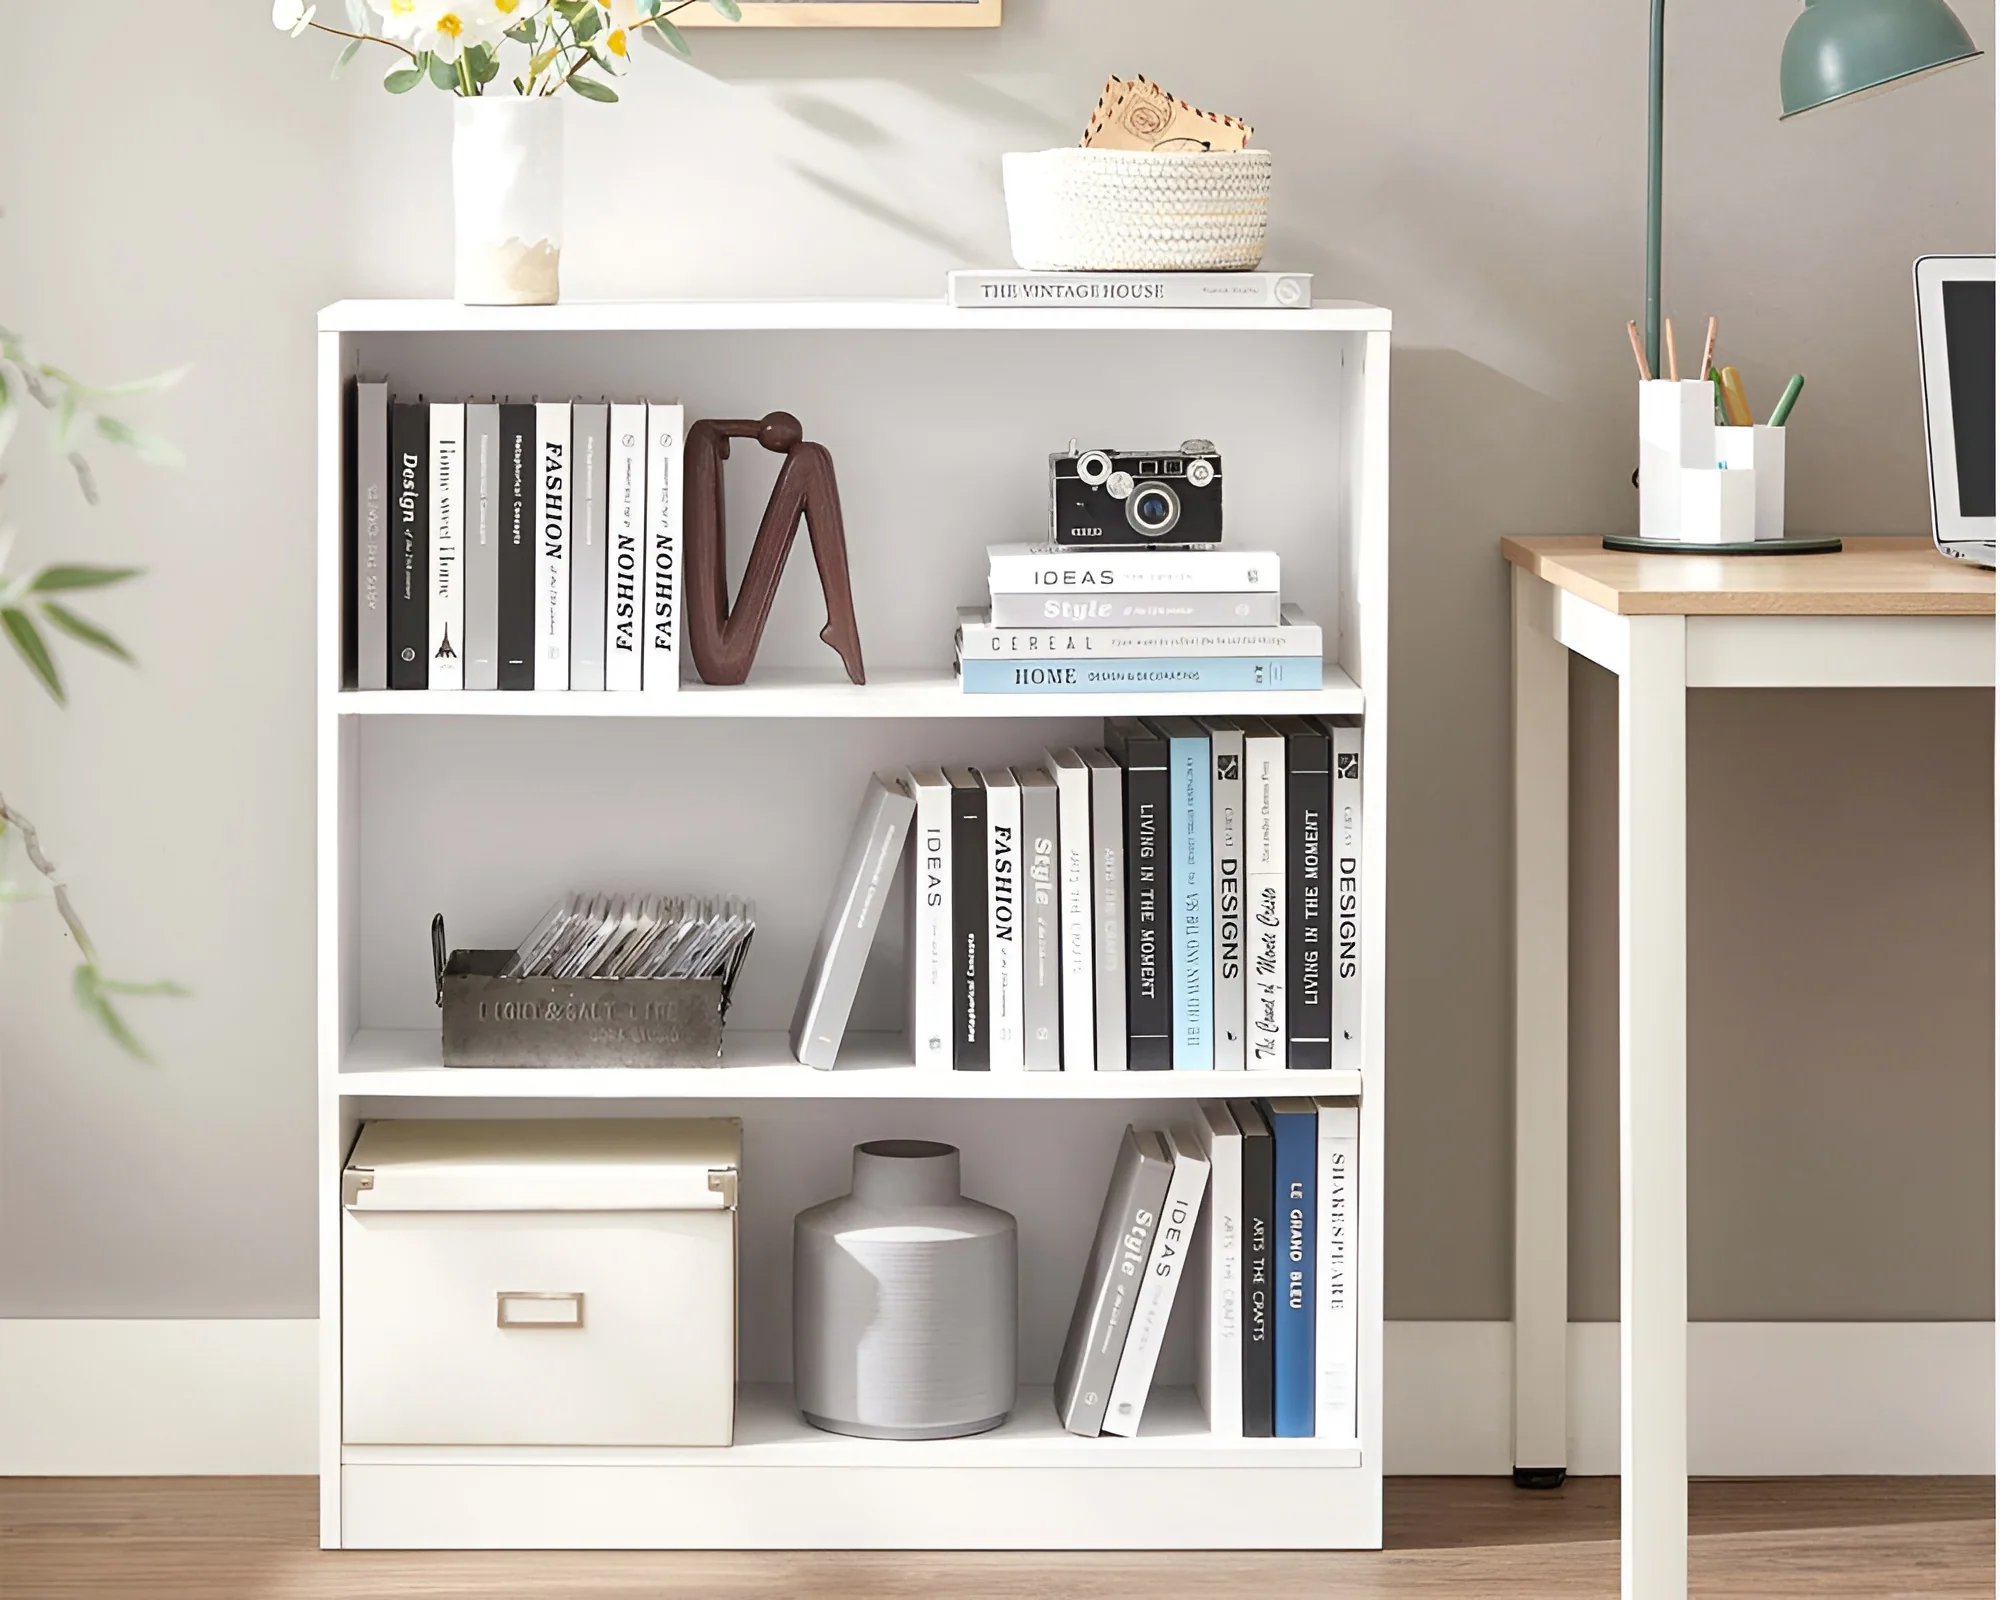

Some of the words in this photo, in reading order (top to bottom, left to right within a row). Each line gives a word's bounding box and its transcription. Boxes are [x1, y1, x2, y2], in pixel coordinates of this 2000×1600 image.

[981, 284, 1018, 299] THE
[1022, 284, 1099, 299] VINTAGE
[1103, 284, 1165, 299] HOUSE
[398, 452, 419, 523] Design
[545, 442, 563, 560] FASHION
[616, 534, 635, 652] FASHION
[654, 533, 673, 652] FASHION
[1033, 570, 1115, 586] IDEAS
[1043, 598, 1114, 621] Style
[991, 635, 1094, 652] CEREAL
[1015, 667, 1078, 685] HOME
[1139, 803, 1155, 858] LIVING
[1303, 809, 1320, 879] MOMENT
[926, 828, 942, 908] IDEAS
[994, 825, 1013, 943] FASHION
[1029, 838, 1053, 906] Style
[1140, 866, 1155, 882] IN
[1140, 888, 1155, 922] THE
[1220, 858, 1239, 980] DESIGNS
[1303, 886, 1320, 919] THE
[1338, 857, 1356, 980] DESIGNS
[1303, 927, 1320, 943] IN
[1140, 929, 1156, 1000] MOMENT
[1303, 951, 1320, 1005] LIVING
[1289, 1181, 1303, 1200] LE
[1121, 1208, 1153, 1277] Style
[1155, 1199, 1189, 1278] IDEAS
[1252, 1217, 1265, 1251] ARTS
[1289, 1209, 1303, 1262] GRAND
[1331, 1152, 1346, 1311] SHAKESPEARE
[1252, 1258, 1265, 1284] THE
[1289, 1271, 1303, 1309] BLEU
[1252, 1291, 1265, 1341] CRAFTS
